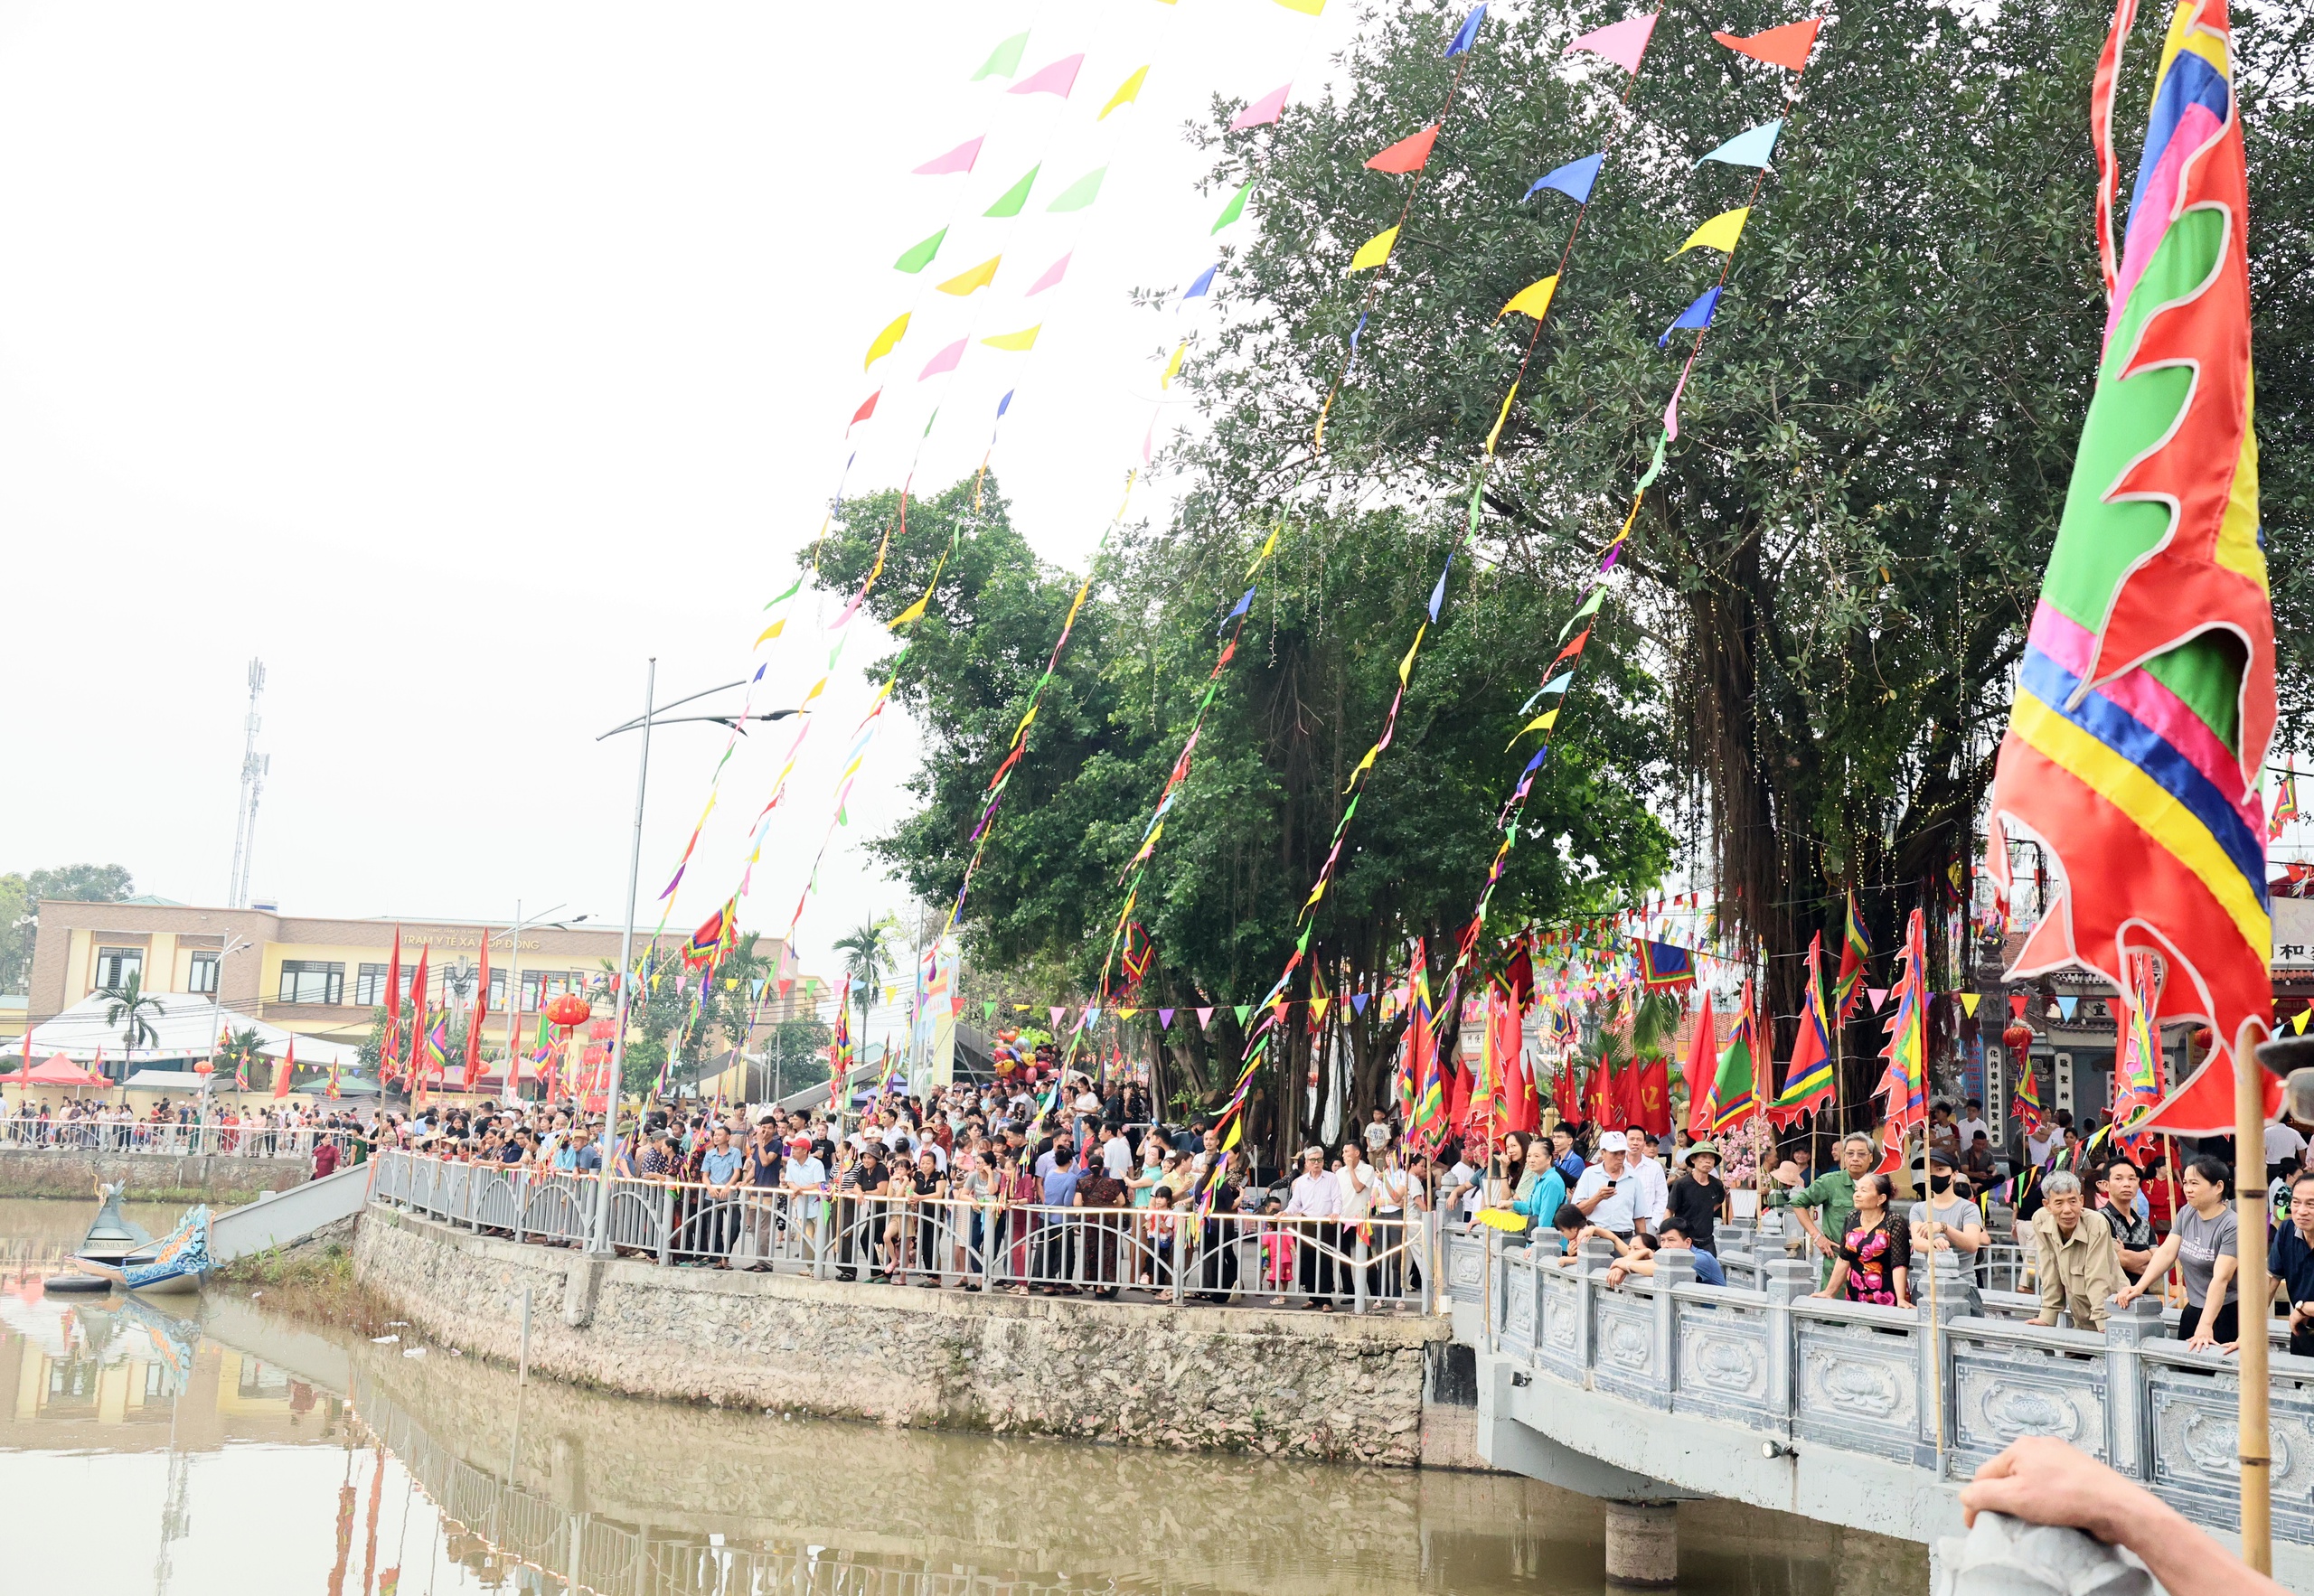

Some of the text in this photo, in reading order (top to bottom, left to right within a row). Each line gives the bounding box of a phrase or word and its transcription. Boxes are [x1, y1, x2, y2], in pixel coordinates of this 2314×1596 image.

[403, 934, 433, 947] TRẠM
[435, 936, 443, 945] Y
[447, 934, 457, 946] TẾ
[459, 935, 476, 947] XÃ
